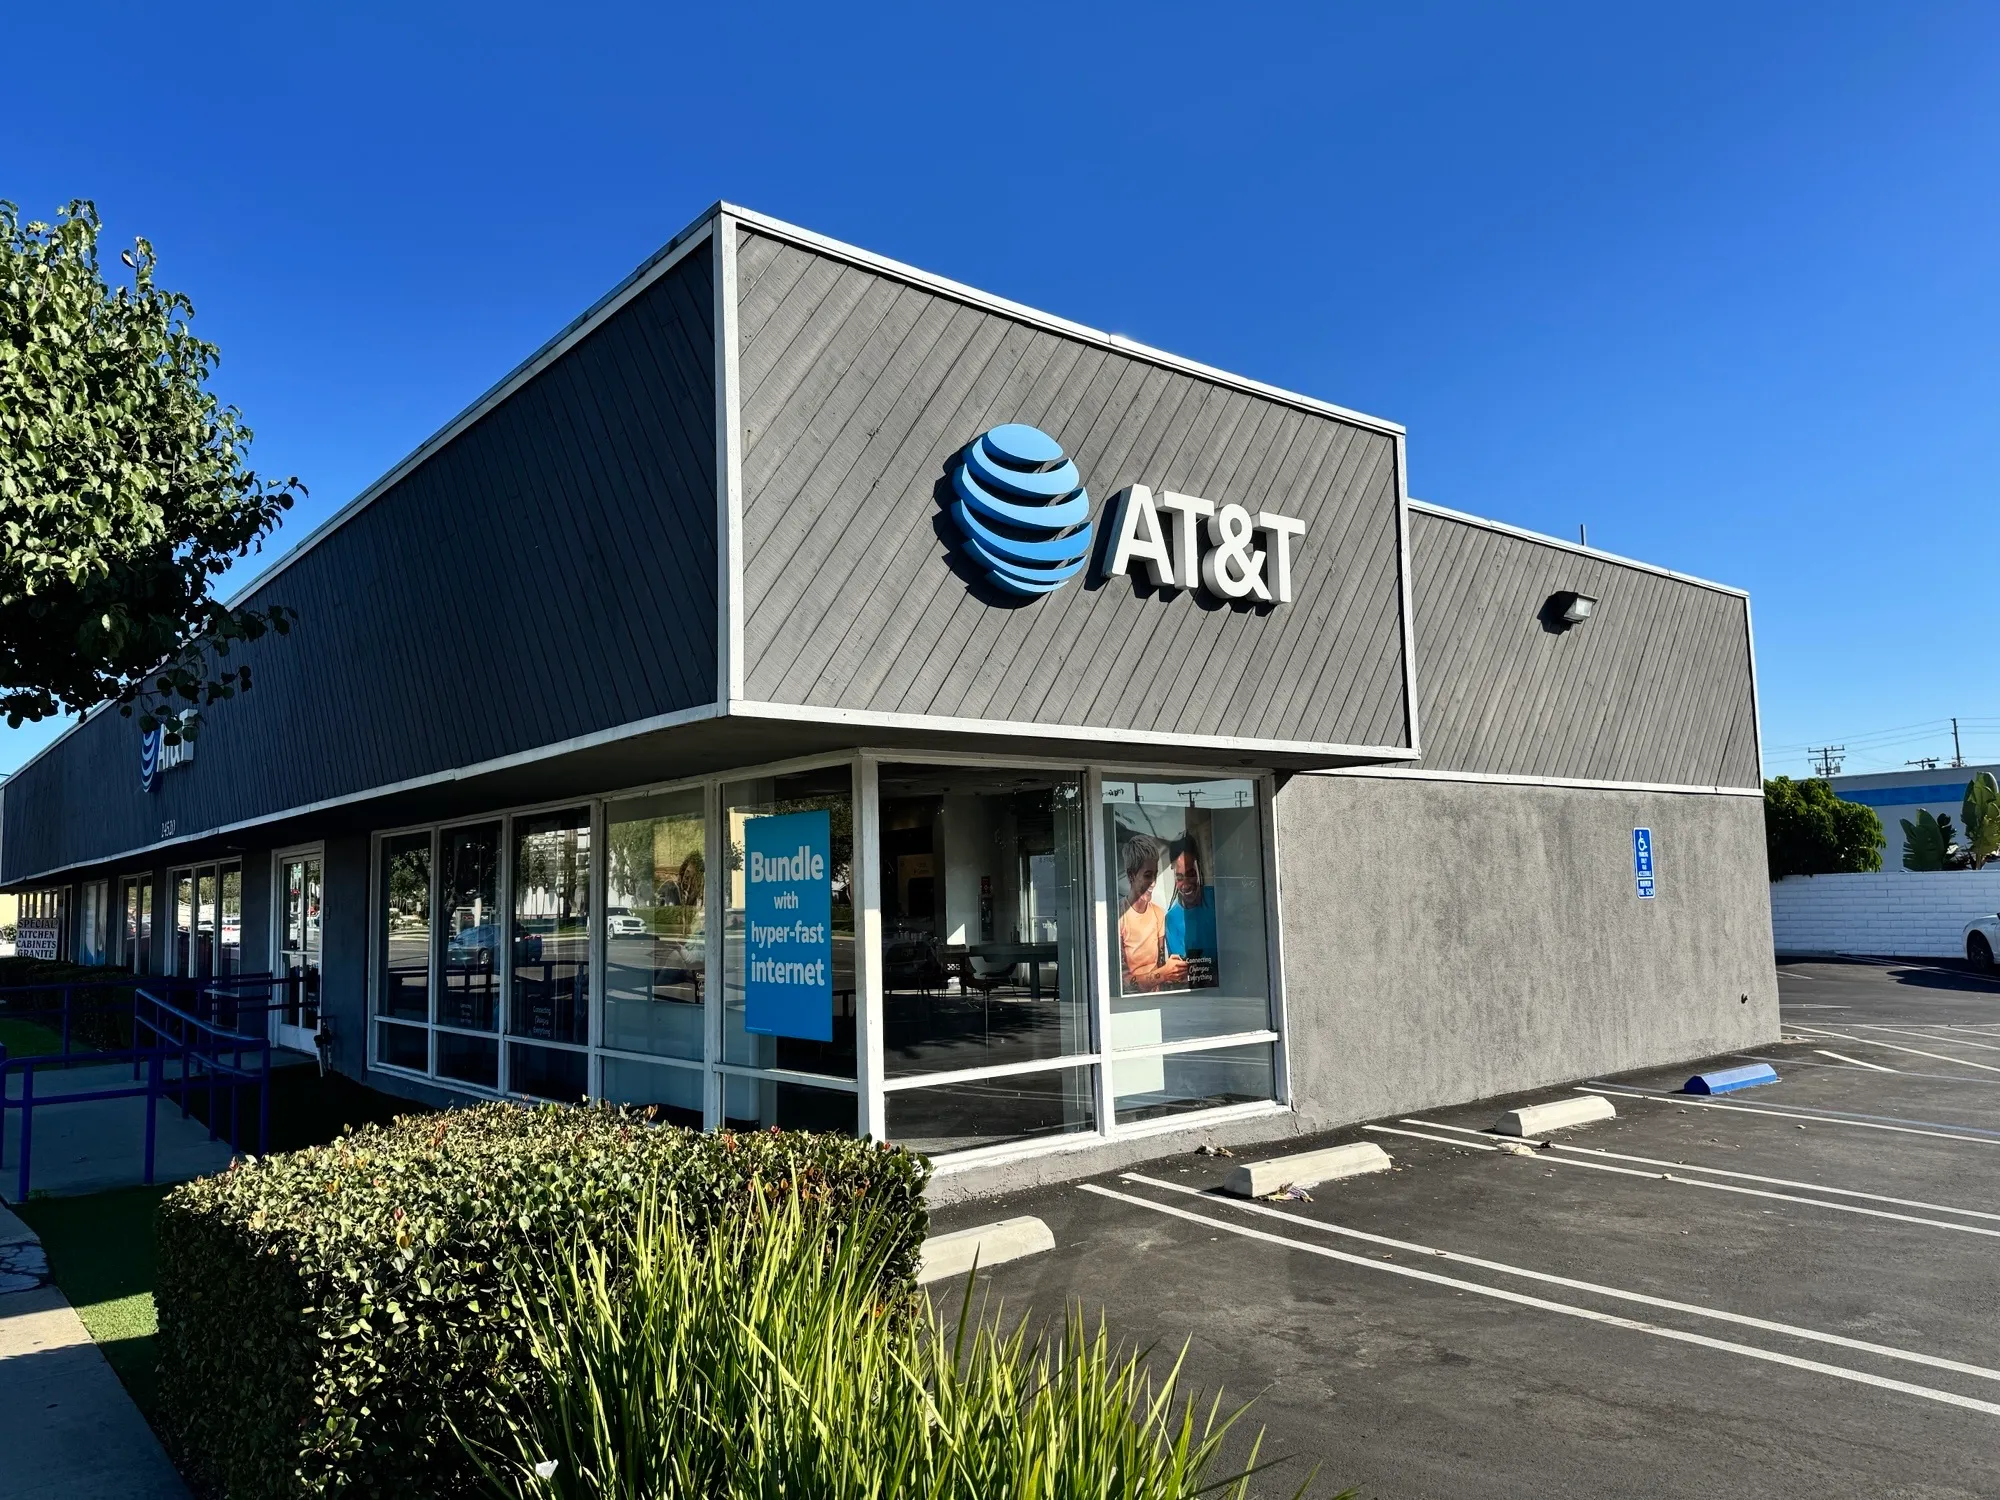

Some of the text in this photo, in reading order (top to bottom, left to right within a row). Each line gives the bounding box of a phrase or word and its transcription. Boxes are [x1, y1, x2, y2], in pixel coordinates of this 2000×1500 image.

[1104, 483, 1306, 604] AT&T
[750, 845, 824, 883] Bundle
[773, 891, 799, 909] with
[16, 940, 57, 949] CABINETS
[18, 930, 55, 939] KITCHEN
[751, 920, 825, 948] hyper-fast
[17, 949, 54, 958] GRANITE
[751, 953, 826, 986] internet
